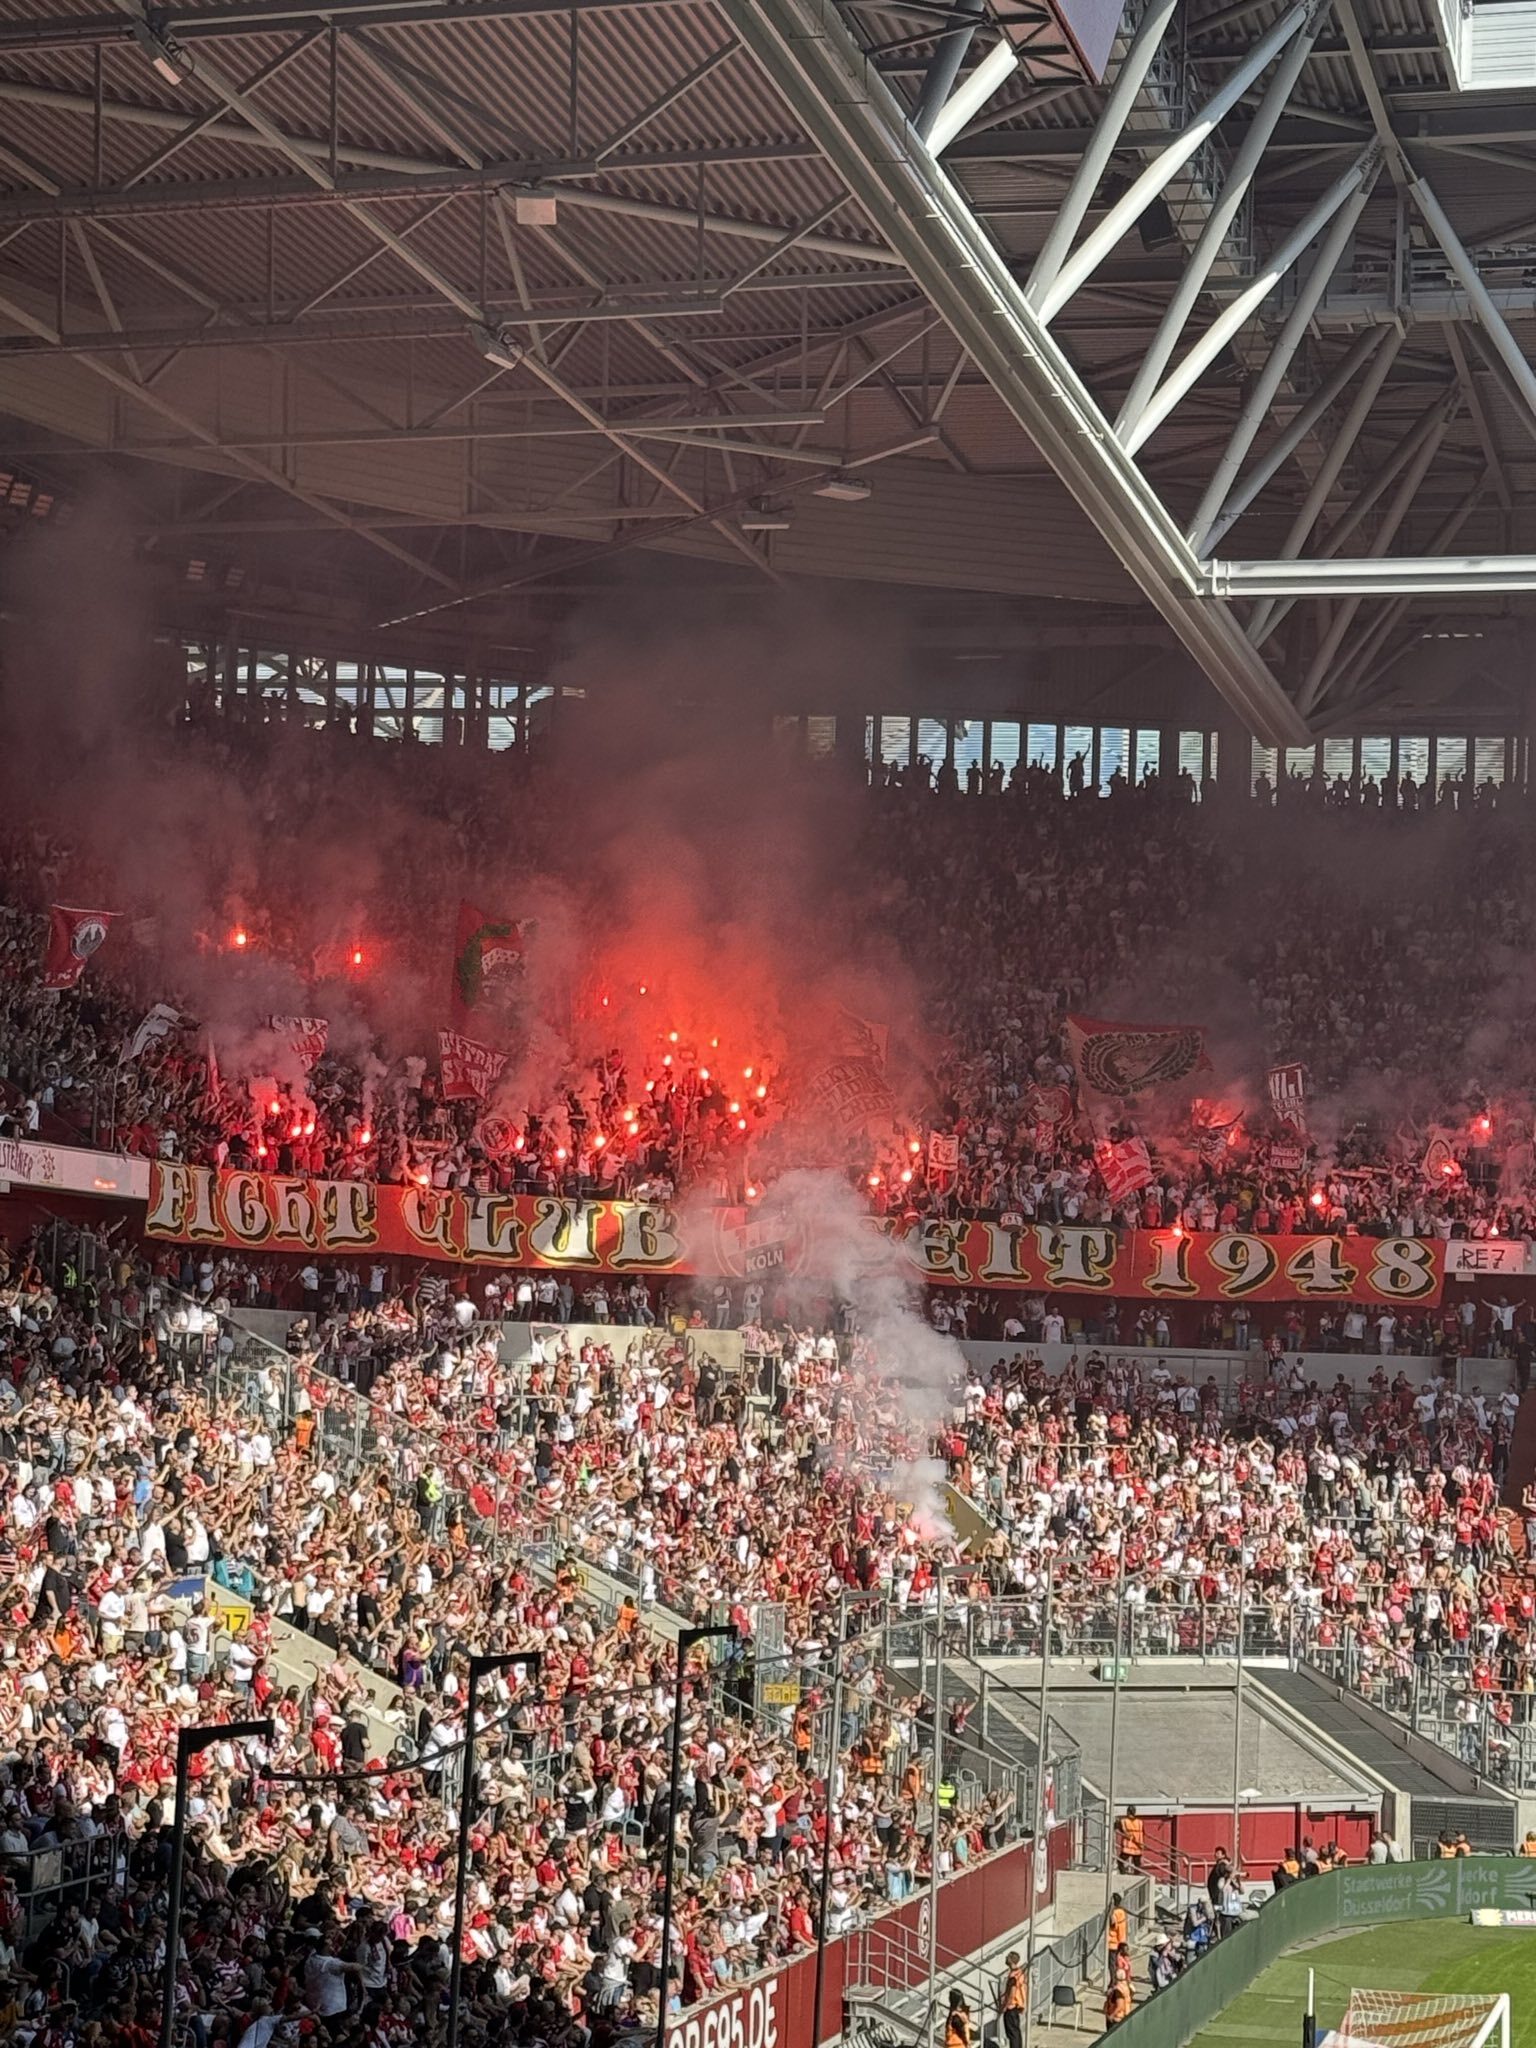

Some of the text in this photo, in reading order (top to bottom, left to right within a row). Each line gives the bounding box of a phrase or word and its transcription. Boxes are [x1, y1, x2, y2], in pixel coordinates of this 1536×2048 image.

[401, 1187, 685, 1269] CLUB
[1143, 1233, 1437, 1299] 1948
[746, 1249, 784, 1273] KÖLN
[225, 1613, 246, 1632] 17
